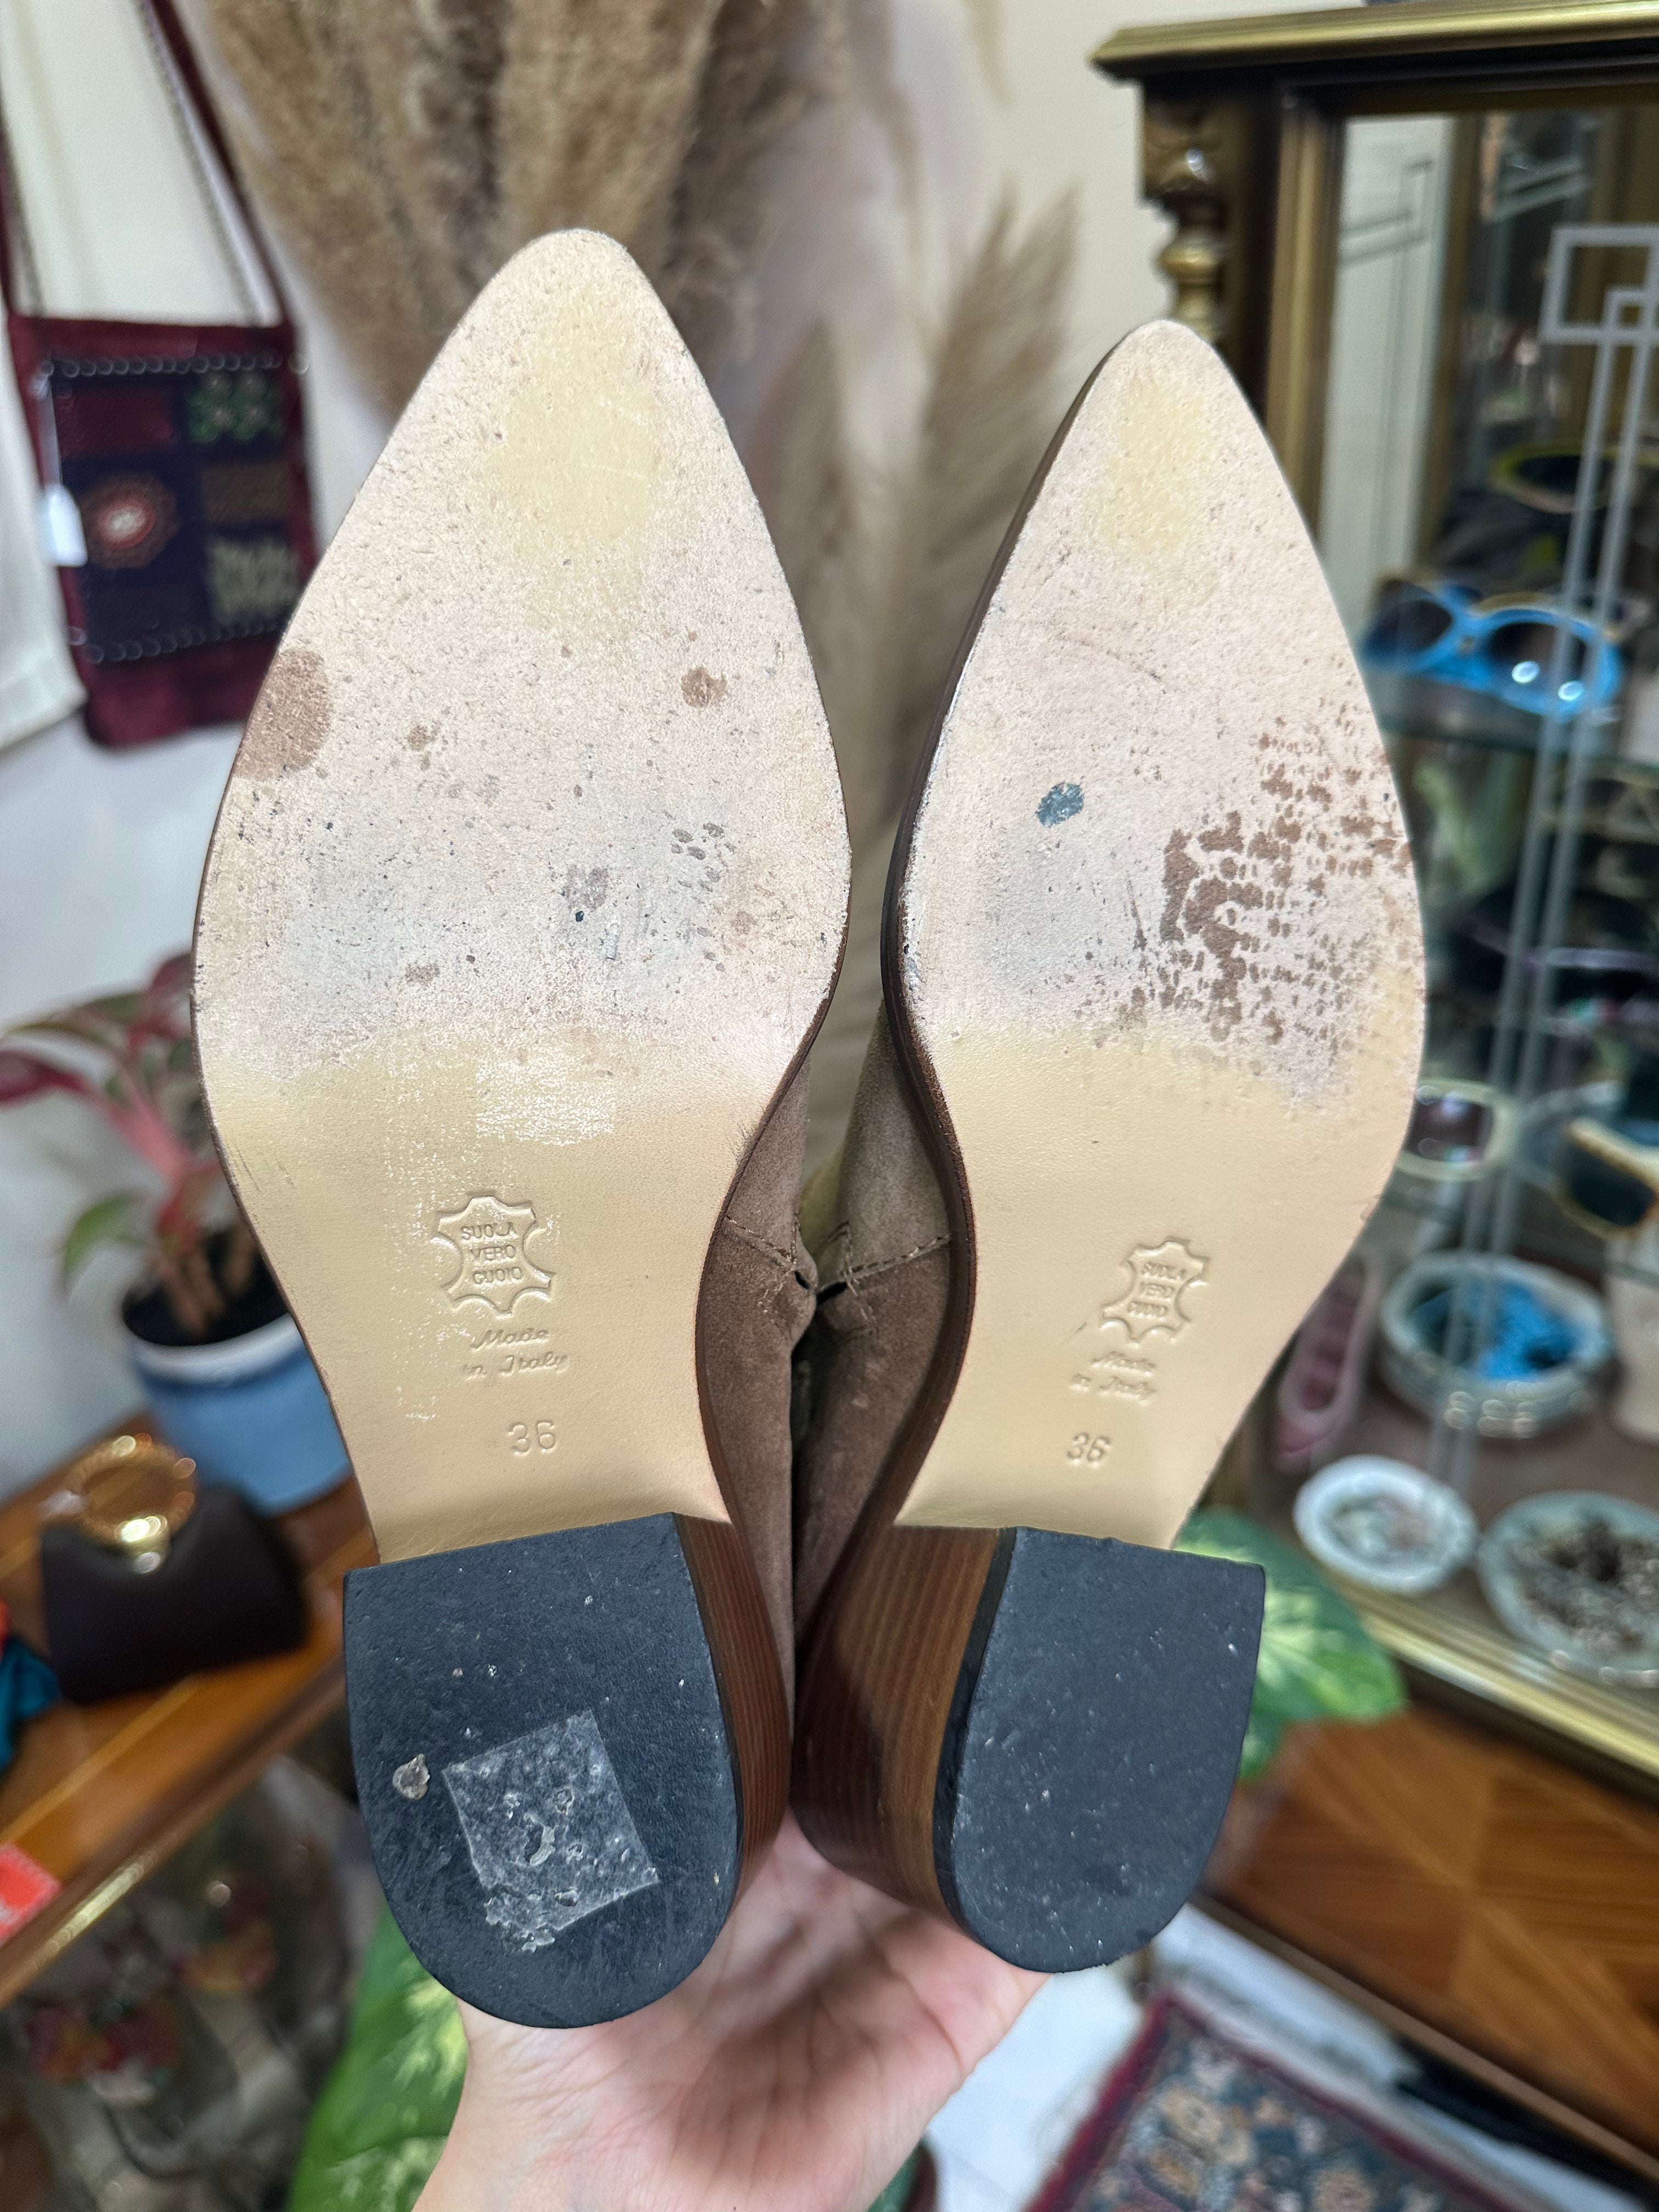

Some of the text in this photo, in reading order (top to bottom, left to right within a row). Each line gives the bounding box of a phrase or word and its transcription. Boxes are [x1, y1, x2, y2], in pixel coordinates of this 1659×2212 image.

[471, 1244, 516, 1261] VERO
[470, 1327, 549, 1350] Made
[509, 1419, 556, 1453] 36
[1067, 1432, 1111, 1462] 36
